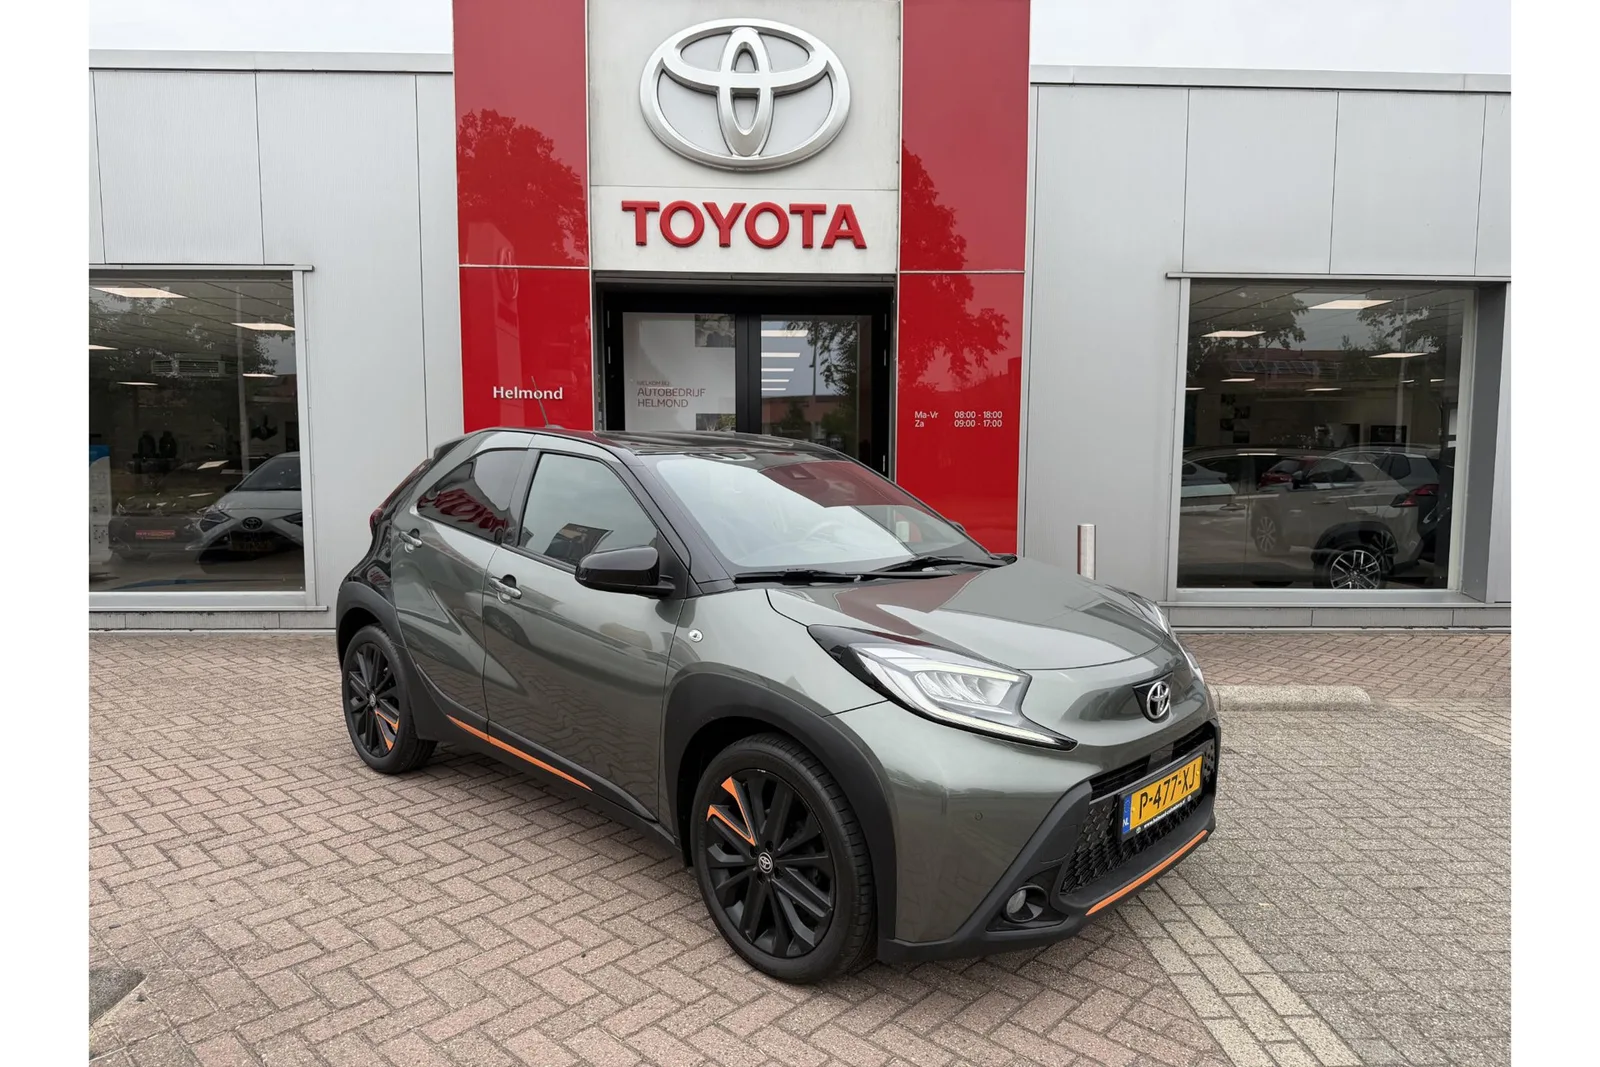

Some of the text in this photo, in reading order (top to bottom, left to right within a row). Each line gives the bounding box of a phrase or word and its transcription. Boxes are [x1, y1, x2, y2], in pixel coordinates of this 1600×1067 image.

[621, 200, 867, 249] TOYOTA
[493, 386, 563, 400] Helmond
[637, 387, 706, 397] AUTOBEDRIJF
[637, 399, 689, 408] HELMOND
[1138, 763, 1197, 820] P-477-XJ
[1122, 817, 1129, 827] NL
